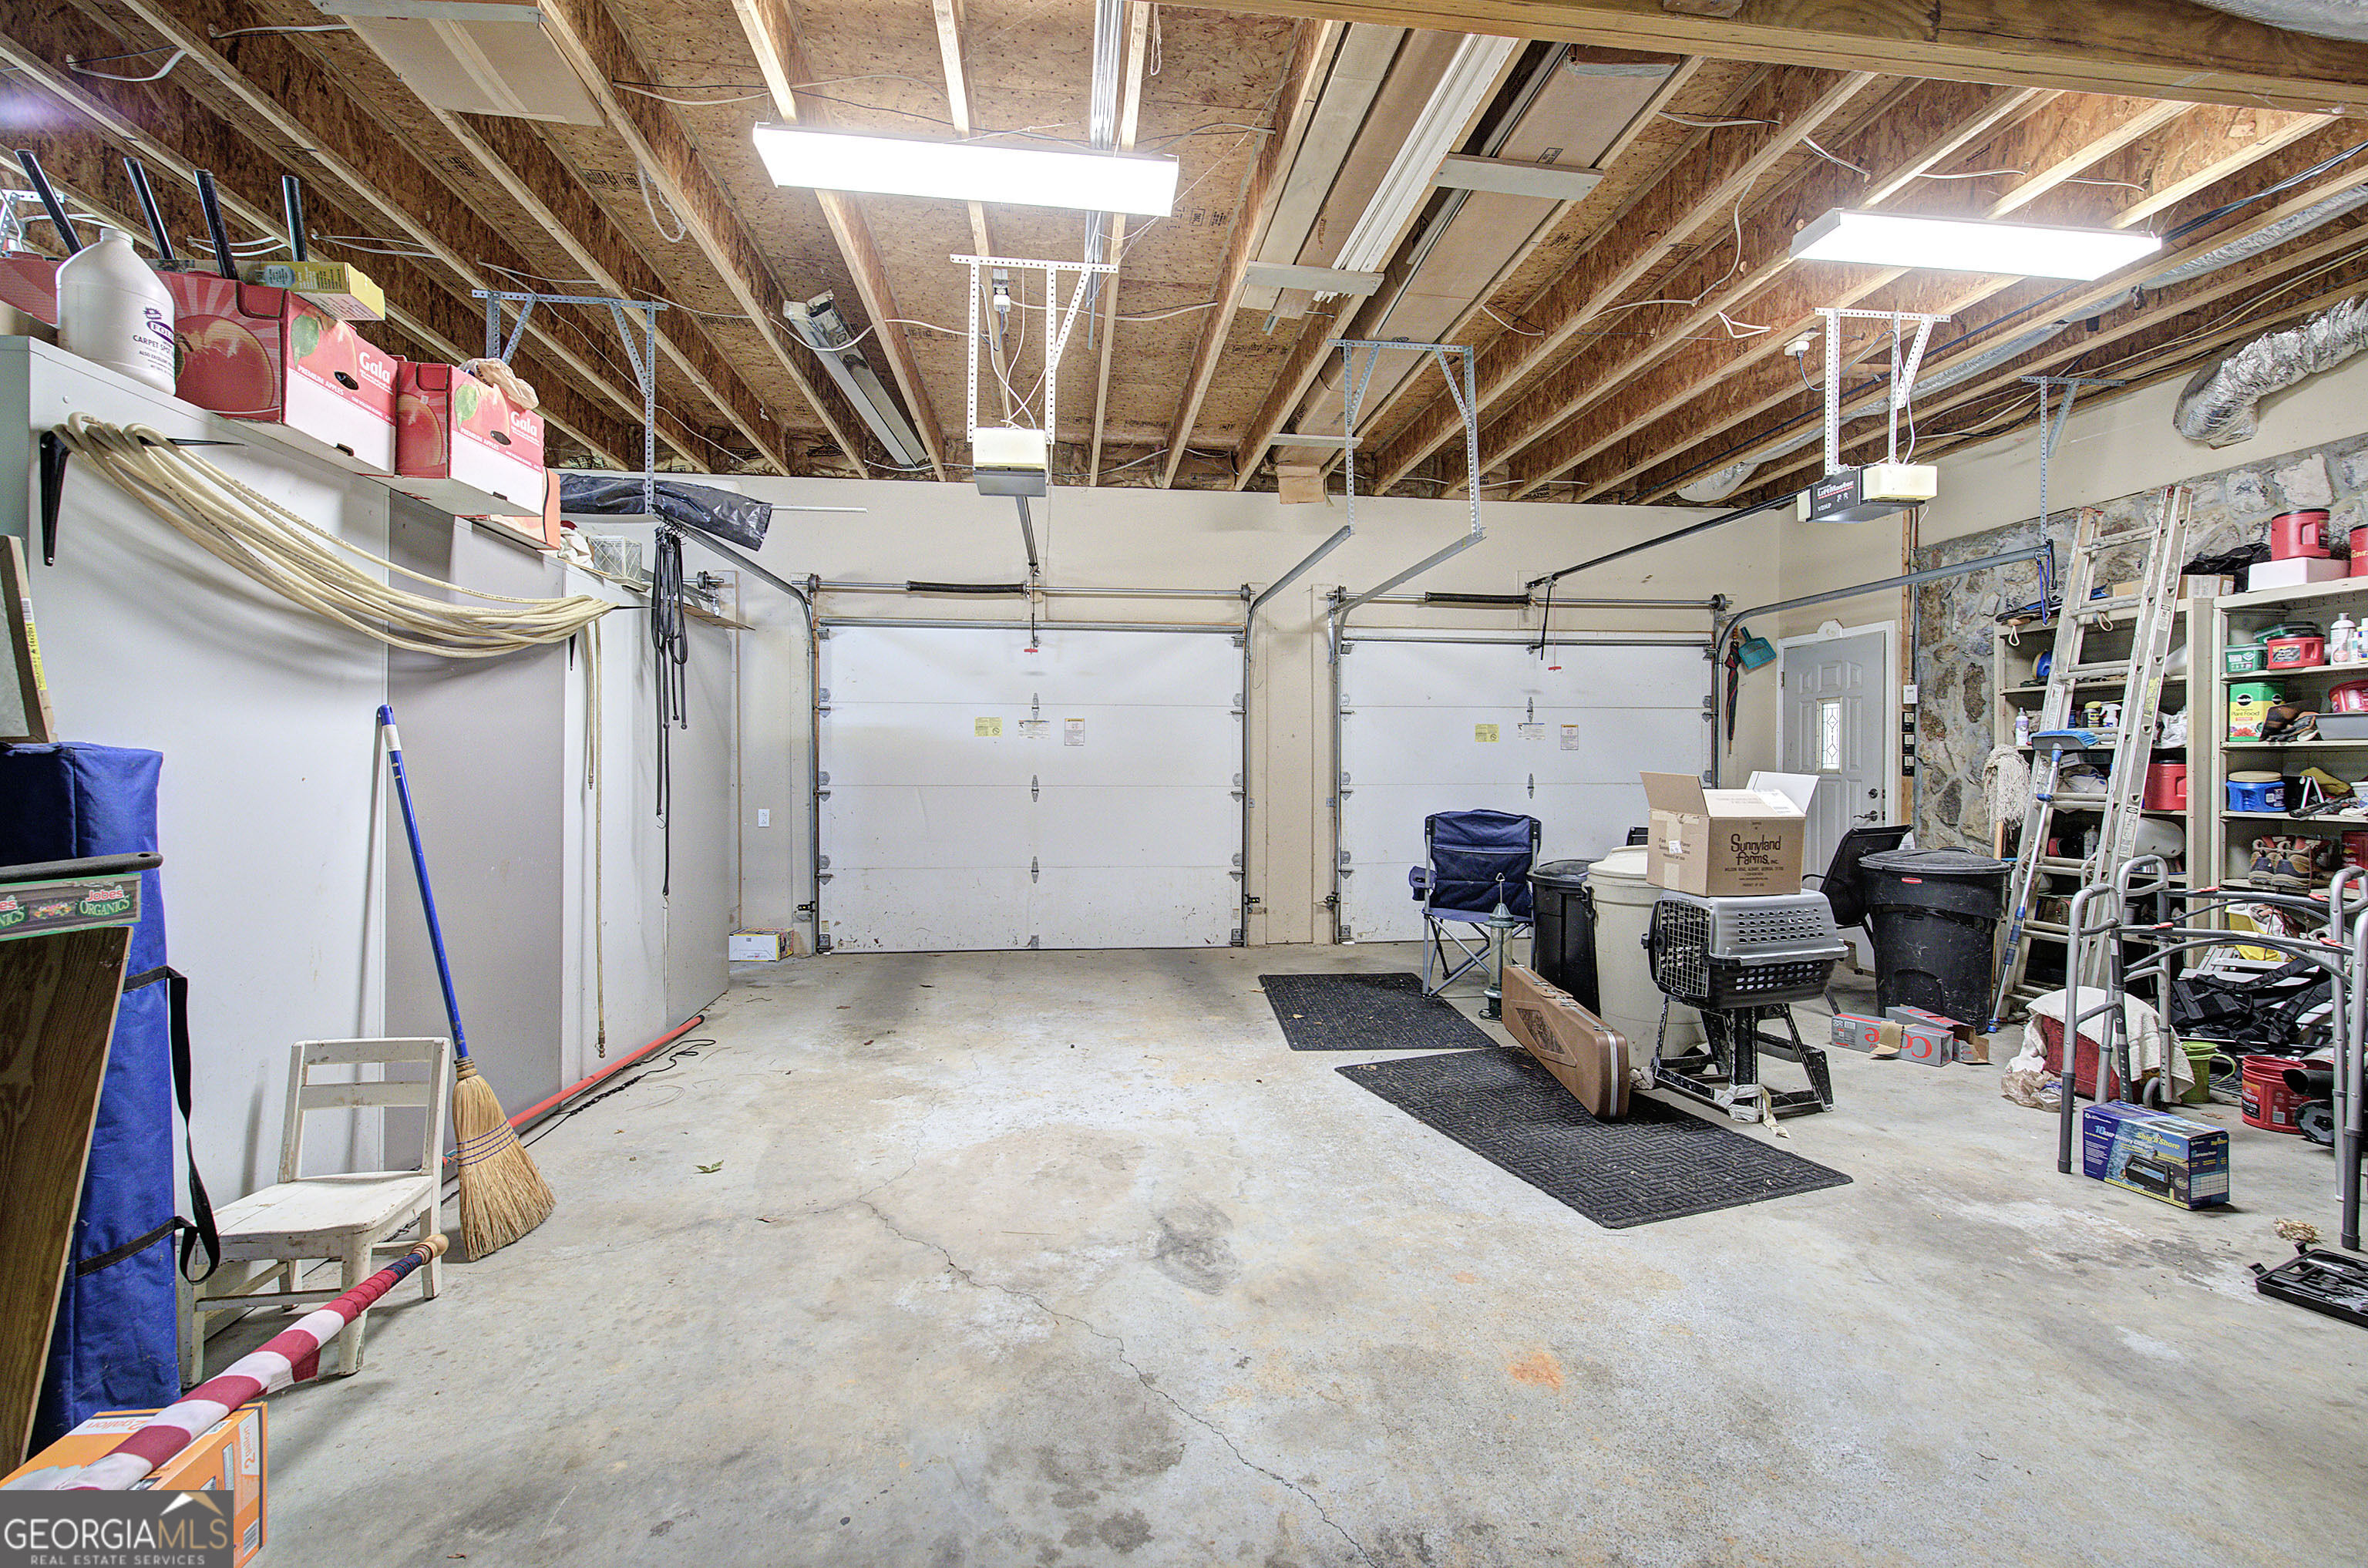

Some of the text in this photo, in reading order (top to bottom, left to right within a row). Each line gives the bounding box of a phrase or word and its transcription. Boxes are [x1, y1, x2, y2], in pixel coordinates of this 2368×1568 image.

[133, 335, 159, 348] CARPET
[359, 352, 390, 384] Gala
[298, 365, 325, 384] PREMIUM
[325, 380, 344, 395] APPLES
[510, 411, 537, 438] Gala
[483, 439, 500, 451] APPLES
[1818, 480, 1854, 496] LiftMaster
[1731, 833, 1781, 854] Sunnyland
[79, 894, 130, 916] ORGANICS
[1864, 1027, 1932, 1058] Coe
[2158, 1139, 2181, 1149] Shore
[86, 1418, 136, 1429] gallon
[243, 1425, 255, 1469] 2 gallon
